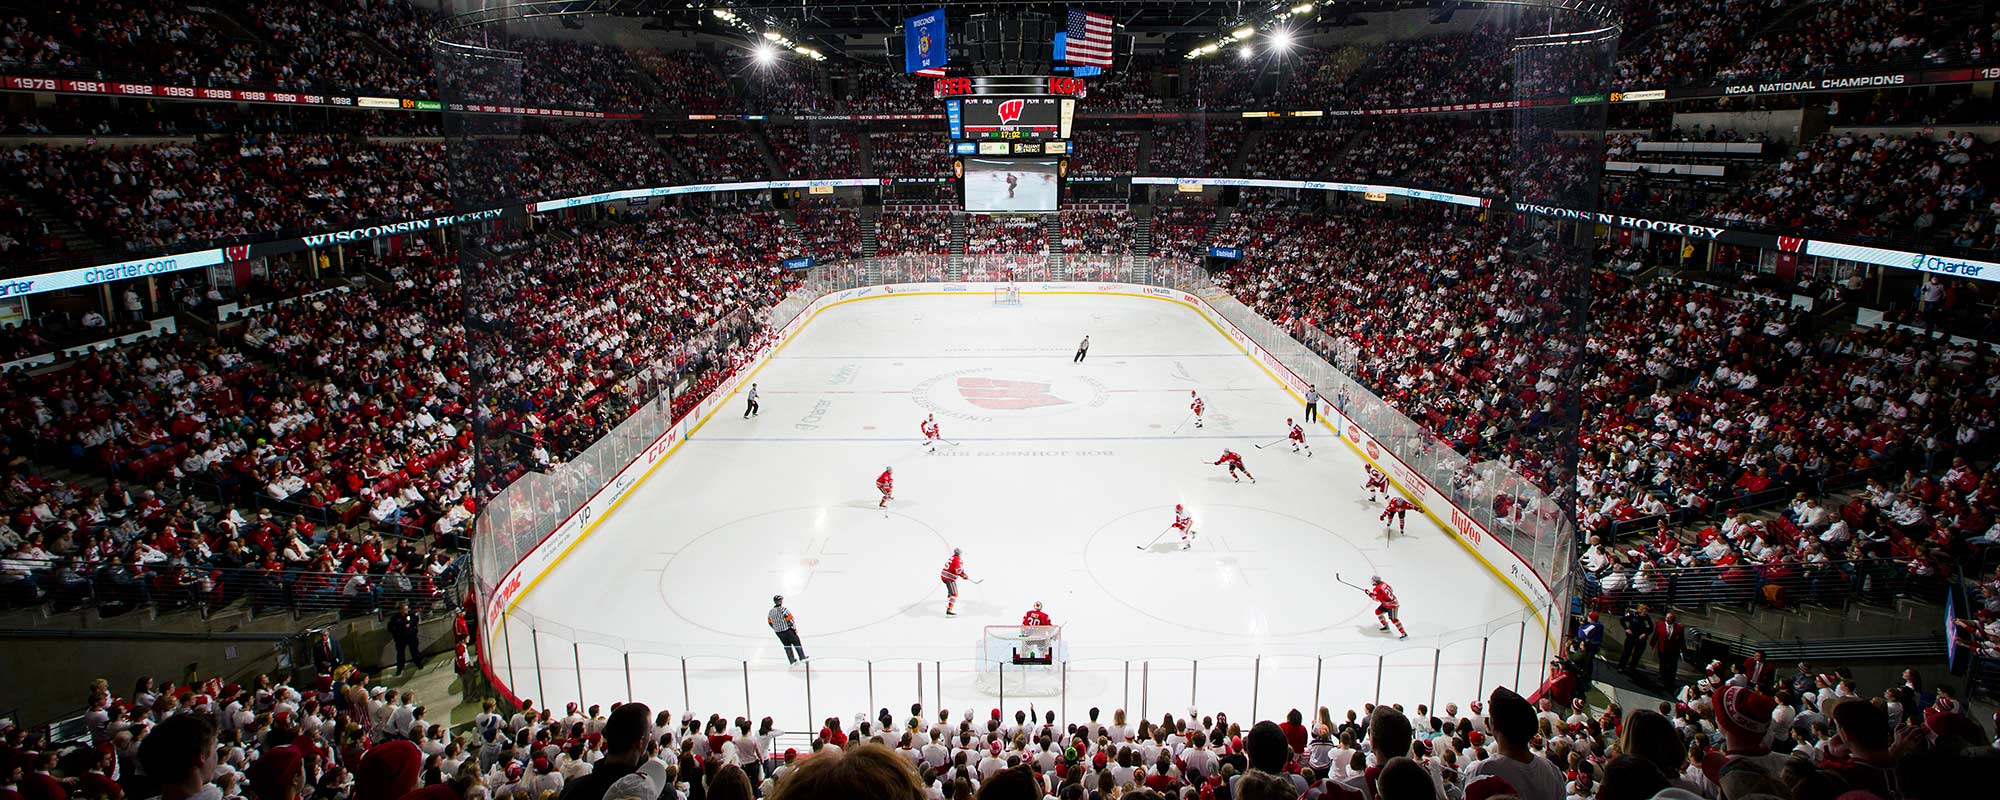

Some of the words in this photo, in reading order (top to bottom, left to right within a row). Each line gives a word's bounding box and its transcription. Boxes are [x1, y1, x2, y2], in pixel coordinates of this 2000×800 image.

[14, 78, 55, 90] 1978
[70, 81, 106, 92] 1981
[119, 84, 152, 95] 1982
[164, 87, 194, 97] 1983
[204, 89, 231, 99] 1988
[240, 92, 265, 100] 1989
[273, 94, 296, 102] 1990
[304, 95, 324, 104] 1991
[331, 97, 351, 105] 1992
[1725, 85, 1754, 94] NCAA
[1759, 81, 1815, 92] NATIONAL
[1822, 75, 1904, 88] CHAMPIONS
[302, 218, 430, 248] WISCONSIN
[435, 208, 503, 228] HOCKEY
[1619, 215, 1725, 239] HOCKEY
[84, 257, 177, 283] charter.com
[1927, 256, 1984, 276] Charter
[1231, 328, 1244, 343] CCM
[648, 430, 677, 464] CCM
[578, 505, 592, 528] yp
[1451, 508, 1481, 545] HyVee
